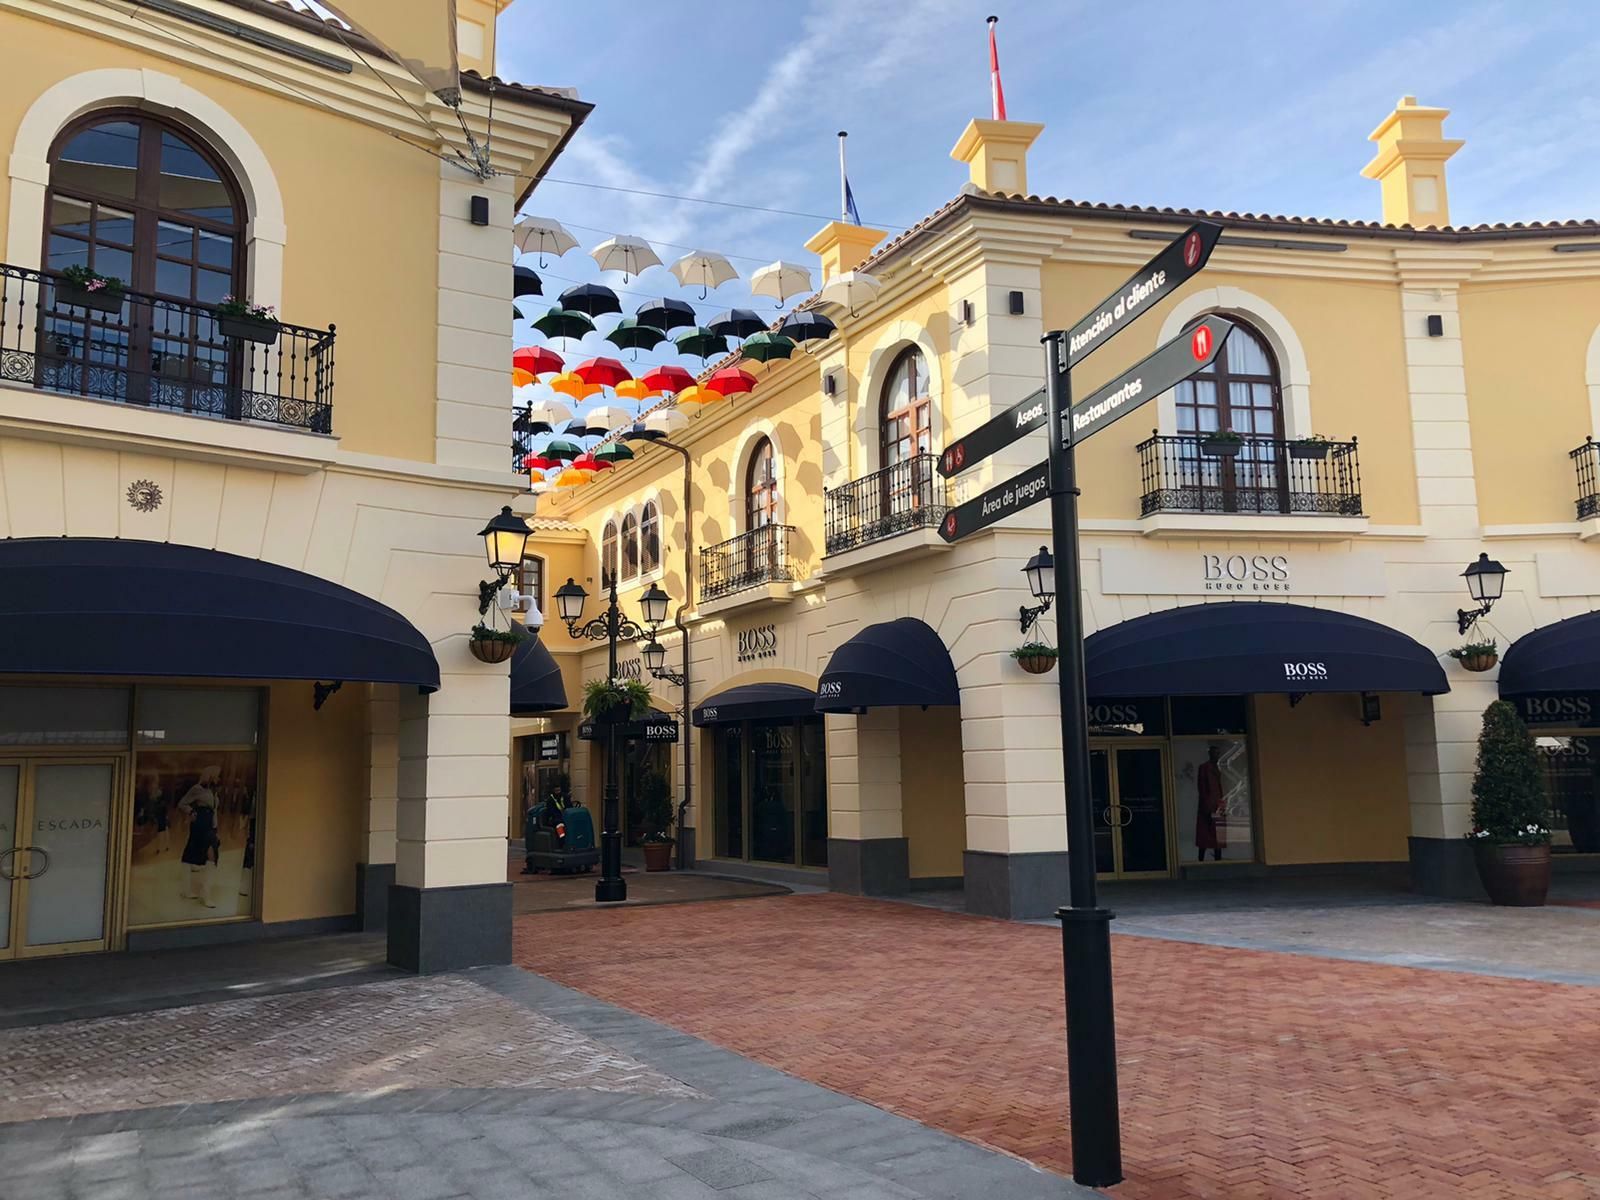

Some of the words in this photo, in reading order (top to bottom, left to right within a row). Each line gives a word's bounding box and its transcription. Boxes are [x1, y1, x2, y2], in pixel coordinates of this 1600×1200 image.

[1069, 312, 1113, 356] Atención
[1114, 303, 1126, 322] al
[1126, 269, 1166, 311] cliente
[1073, 377, 1142, 432] Restaurantes
[1015, 401, 1043, 428] Aseos
[982, 497, 1002, 516] Área
[1002, 488, 1015, 508] de
[1014, 475, 1046, 503] juegos
[1203, 555, 1289, 581] BOSS
[1205, 582, 1243, 590] HUGO
[1253, 582, 1291, 590] BOSS
[738, 624, 776, 653] BOSS
[615, 658, 641, 679] BOSS
[1284, 662, 1327, 677] BOSS
[820, 682, 842, 695] BOSS
[703, 708, 718, 718] BOSS
[1526, 697, 1591, 715] BOSS
[646, 725, 676, 736] BOSS
[767, 731, 793, 748] BOSS
[38, 819, 102, 831] ESCADA
